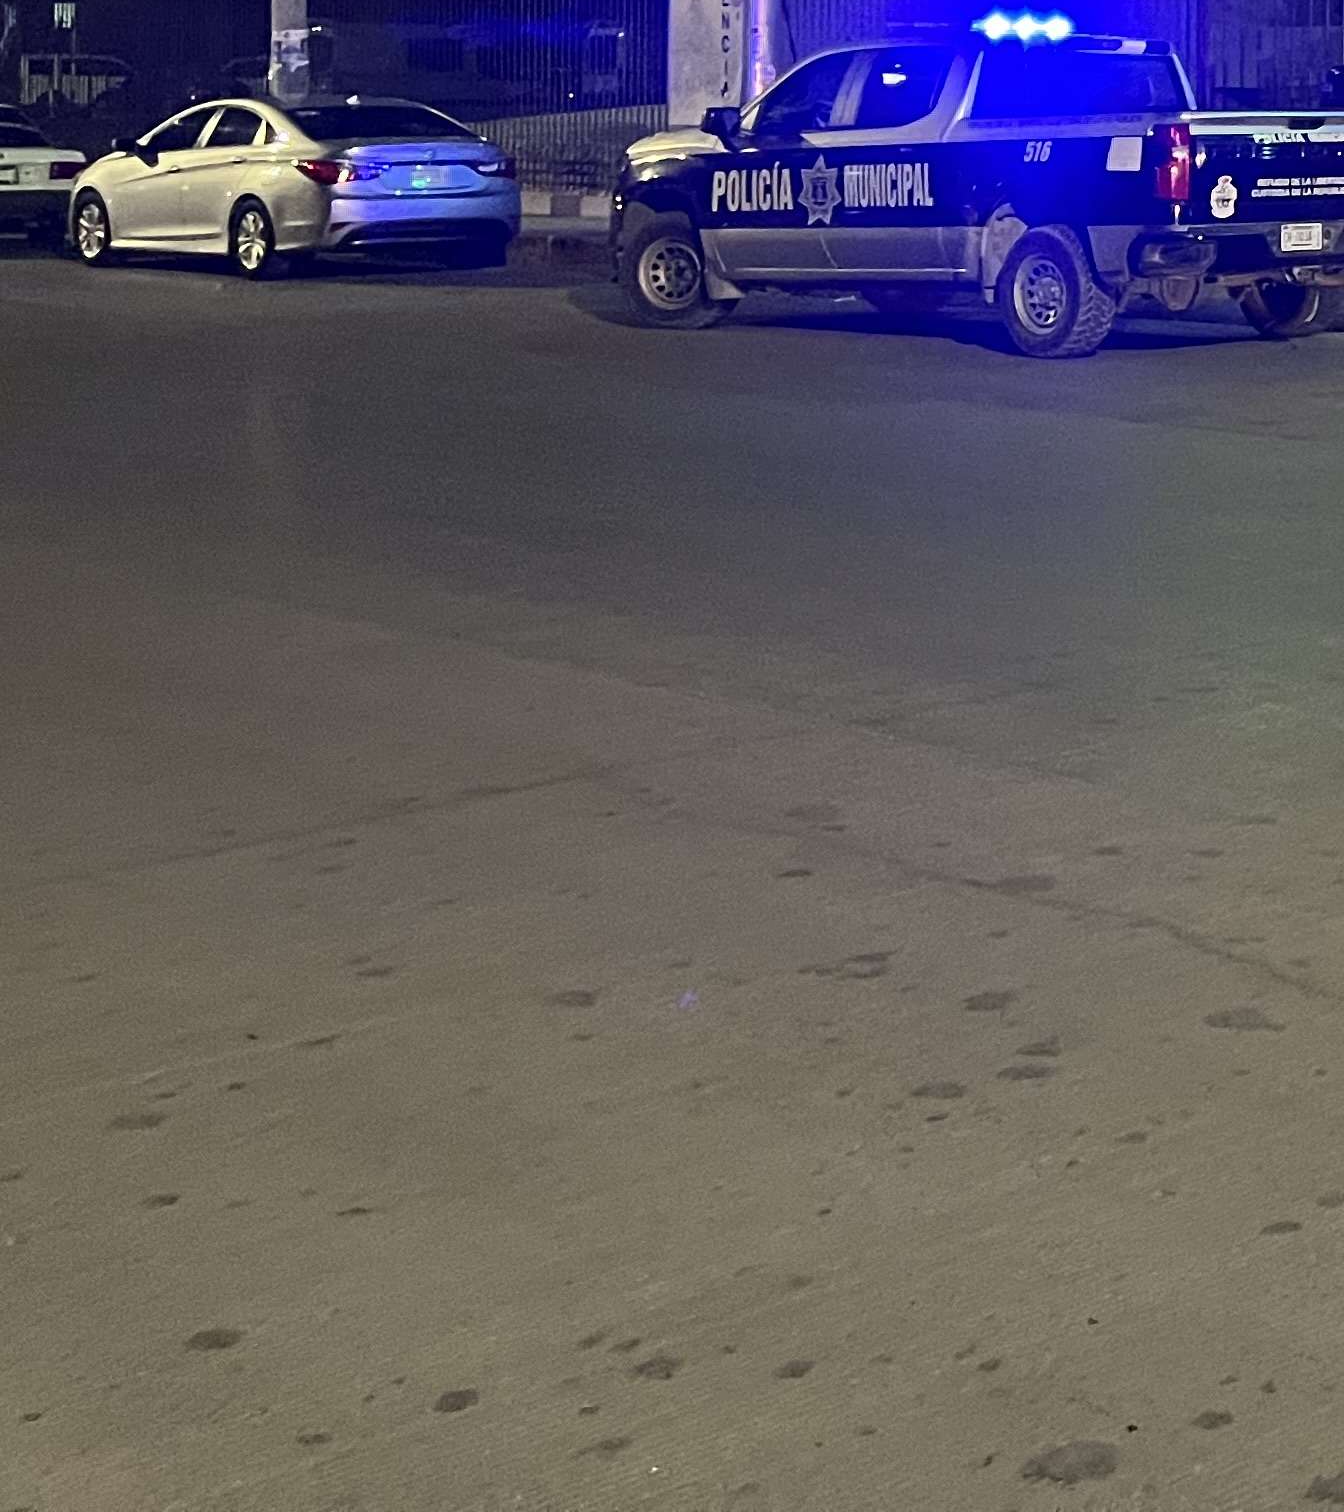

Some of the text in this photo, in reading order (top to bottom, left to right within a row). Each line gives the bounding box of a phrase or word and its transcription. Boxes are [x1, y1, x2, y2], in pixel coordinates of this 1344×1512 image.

[1023, 141, 1052, 162] 516
[711, 161, 934, 212] POLICÍA MUNICIPAL
